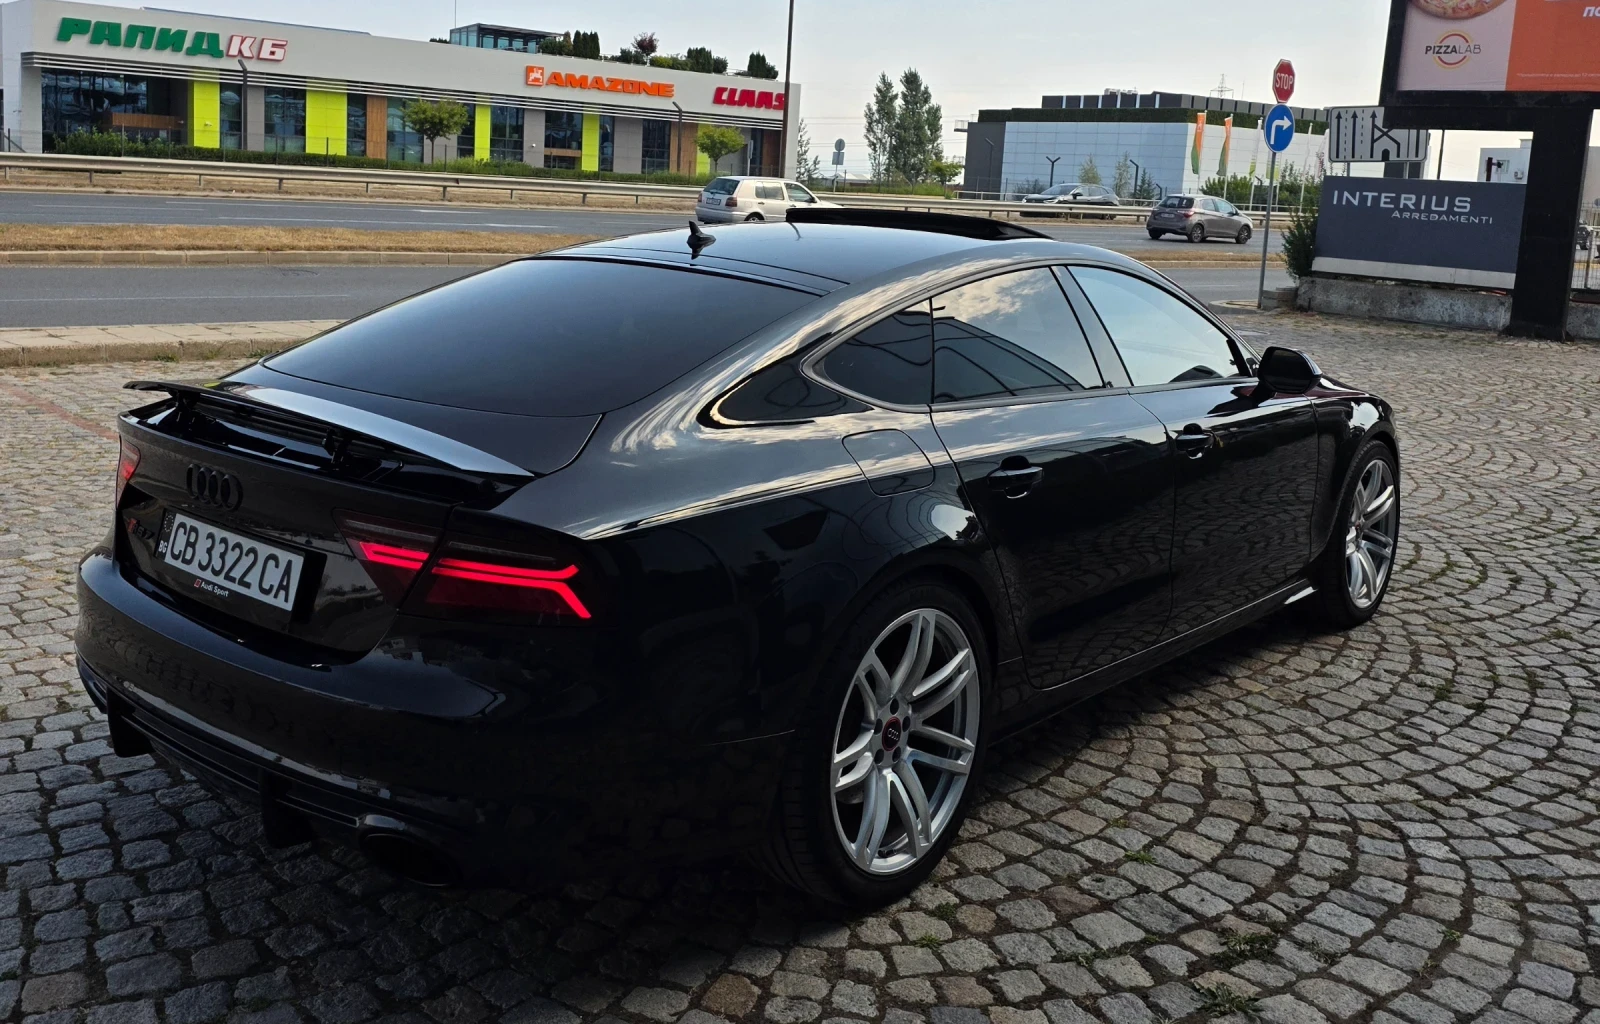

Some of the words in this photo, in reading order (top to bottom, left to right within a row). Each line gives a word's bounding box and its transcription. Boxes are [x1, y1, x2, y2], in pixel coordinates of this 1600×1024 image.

[57, 17, 224, 58] РАПИД
[226, 35, 288, 61] КБ
[1425, 43, 1481, 55] PIZZALAB
[546, 71, 674, 98] AMAZONE
[1275, 72, 1294, 90] STOP
[712, 86, 785, 110] CLAAS
[1333, 189, 1471, 213] INTERIUS
[158, 540, 168, 553] BG
[198, 532, 258, 589] 3322
[201, 581, 213, 591] Audi
[213, 585, 229, 597] Sport
